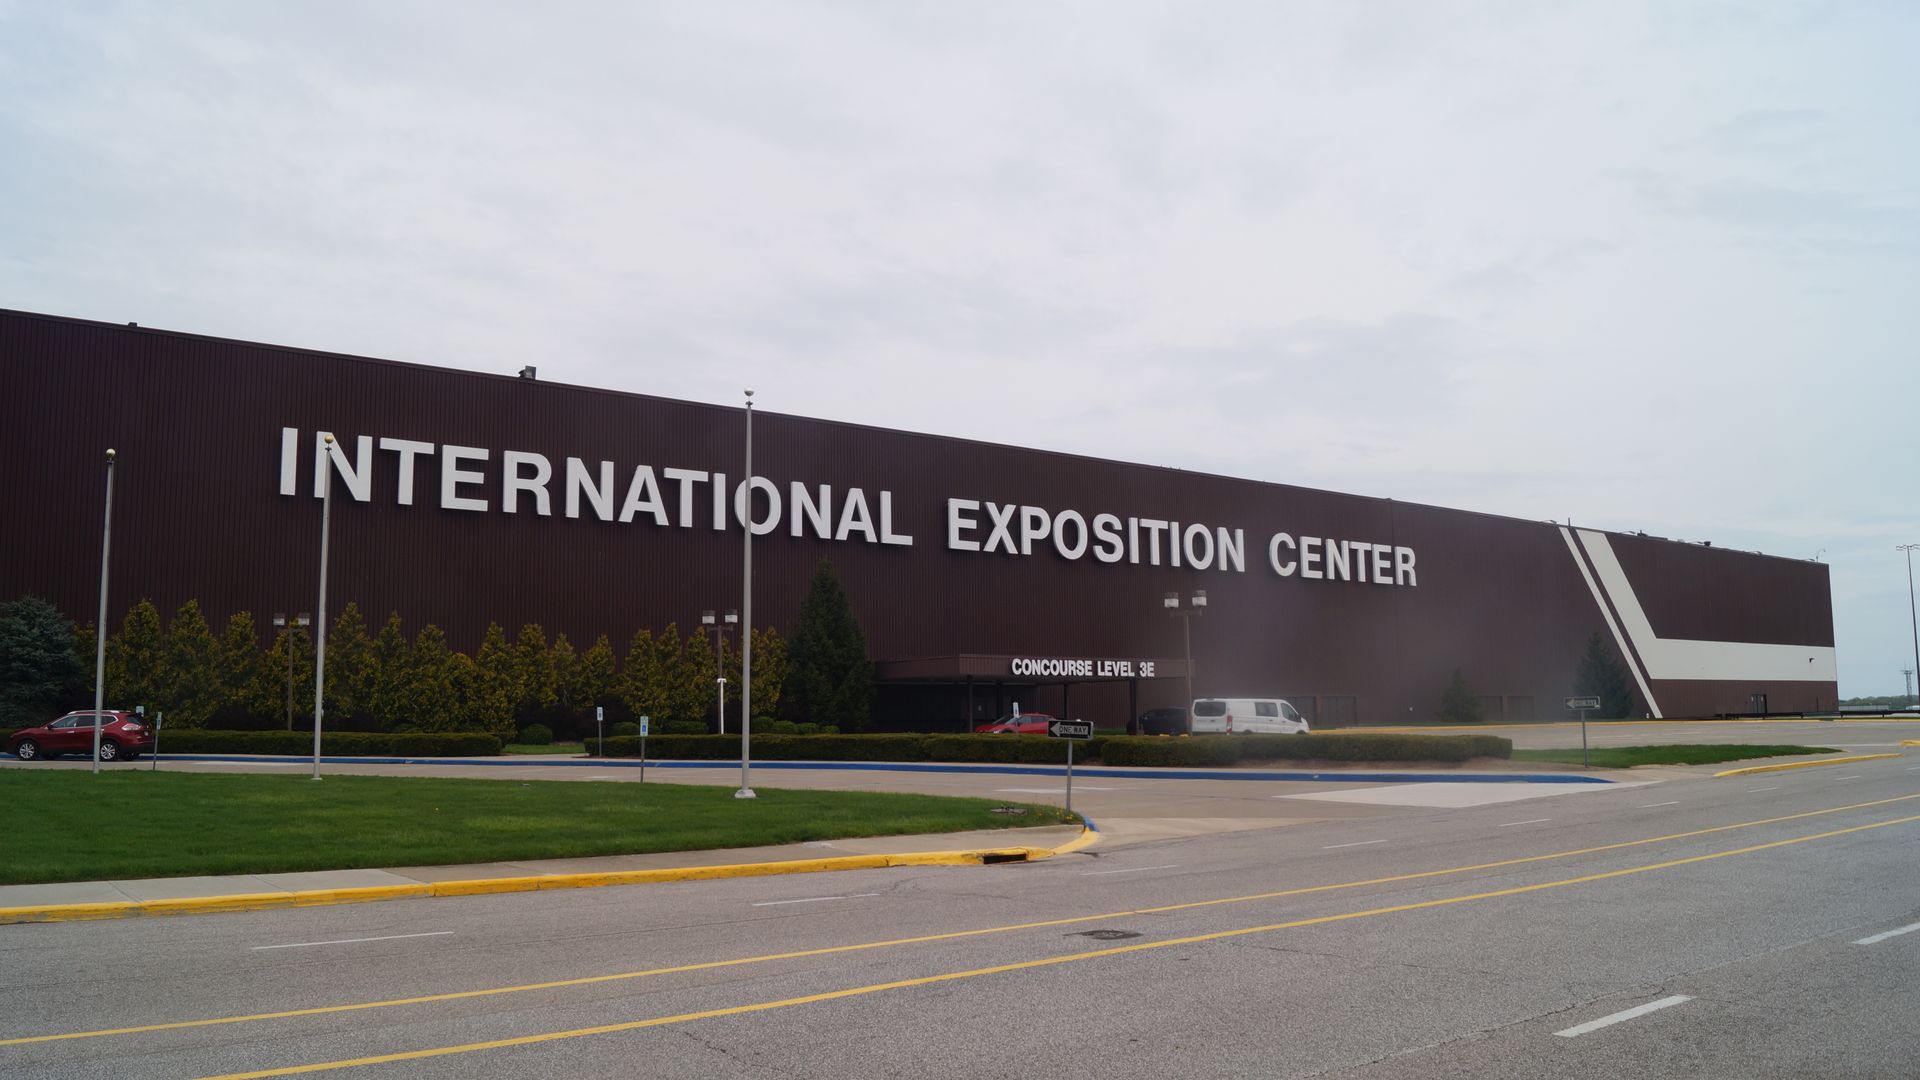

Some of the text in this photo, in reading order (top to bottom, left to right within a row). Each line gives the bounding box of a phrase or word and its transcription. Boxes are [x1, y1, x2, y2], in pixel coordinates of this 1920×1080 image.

[280, 427, 1417, 586] INTERNATIONAL EXPOSITION CENTER
[1012, 658, 1155, 677] CONCOURSE LEVEL 3E
[1073, 726, 1087, 734] WAY
